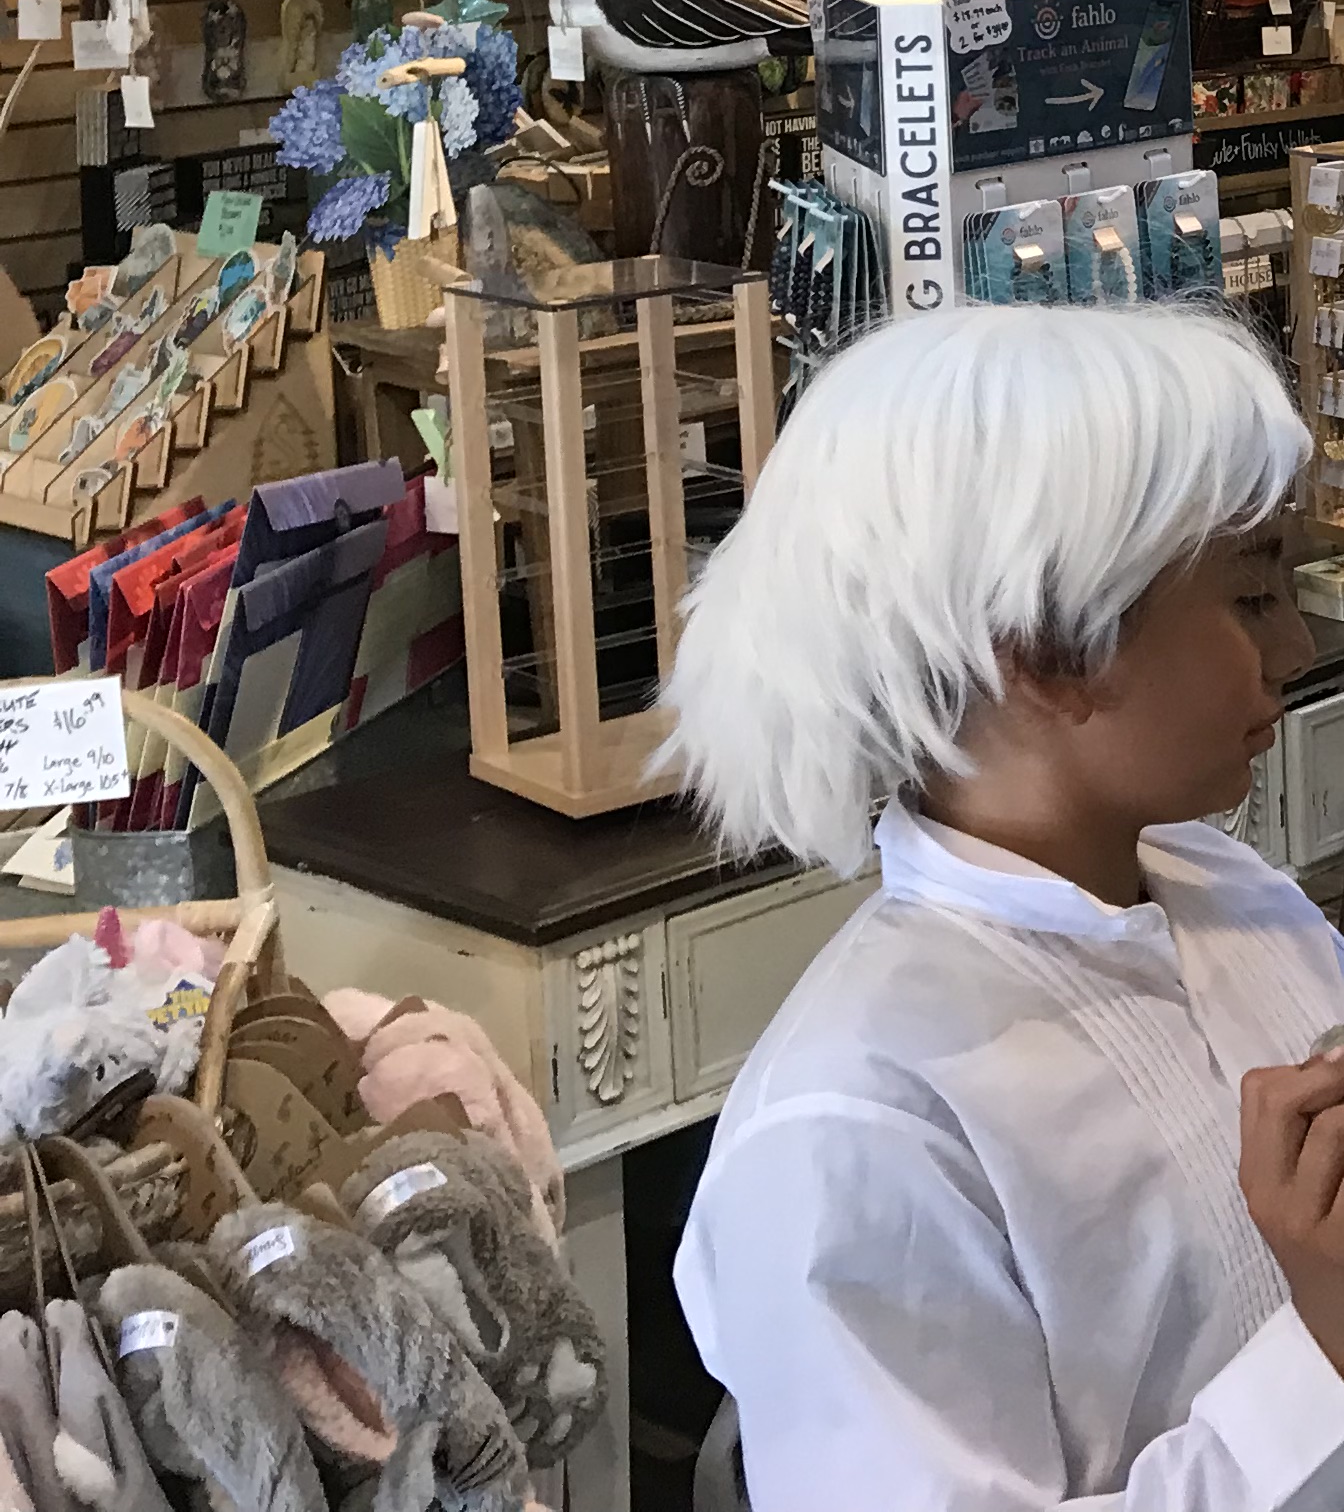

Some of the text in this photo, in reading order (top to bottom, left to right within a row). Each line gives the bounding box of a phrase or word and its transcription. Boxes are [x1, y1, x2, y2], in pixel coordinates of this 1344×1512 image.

[1071, 2, 1117, 29] fahlo
[959, 35, 970, 49] 2
[1016, 36, 1129, 62] Track an Animal
[894, 34, 942, 261] BRACELETS
[1241, 132, 1279, 161] Funky
[1178, 192, 1201, 206] fahlo
[1097, 208, 1119, 222] fahlo
[1019, 224, 1043, 239] fahlo
[1229, 268, 1273, 289] HOUSE
[43, 754, 82, 777] Large
